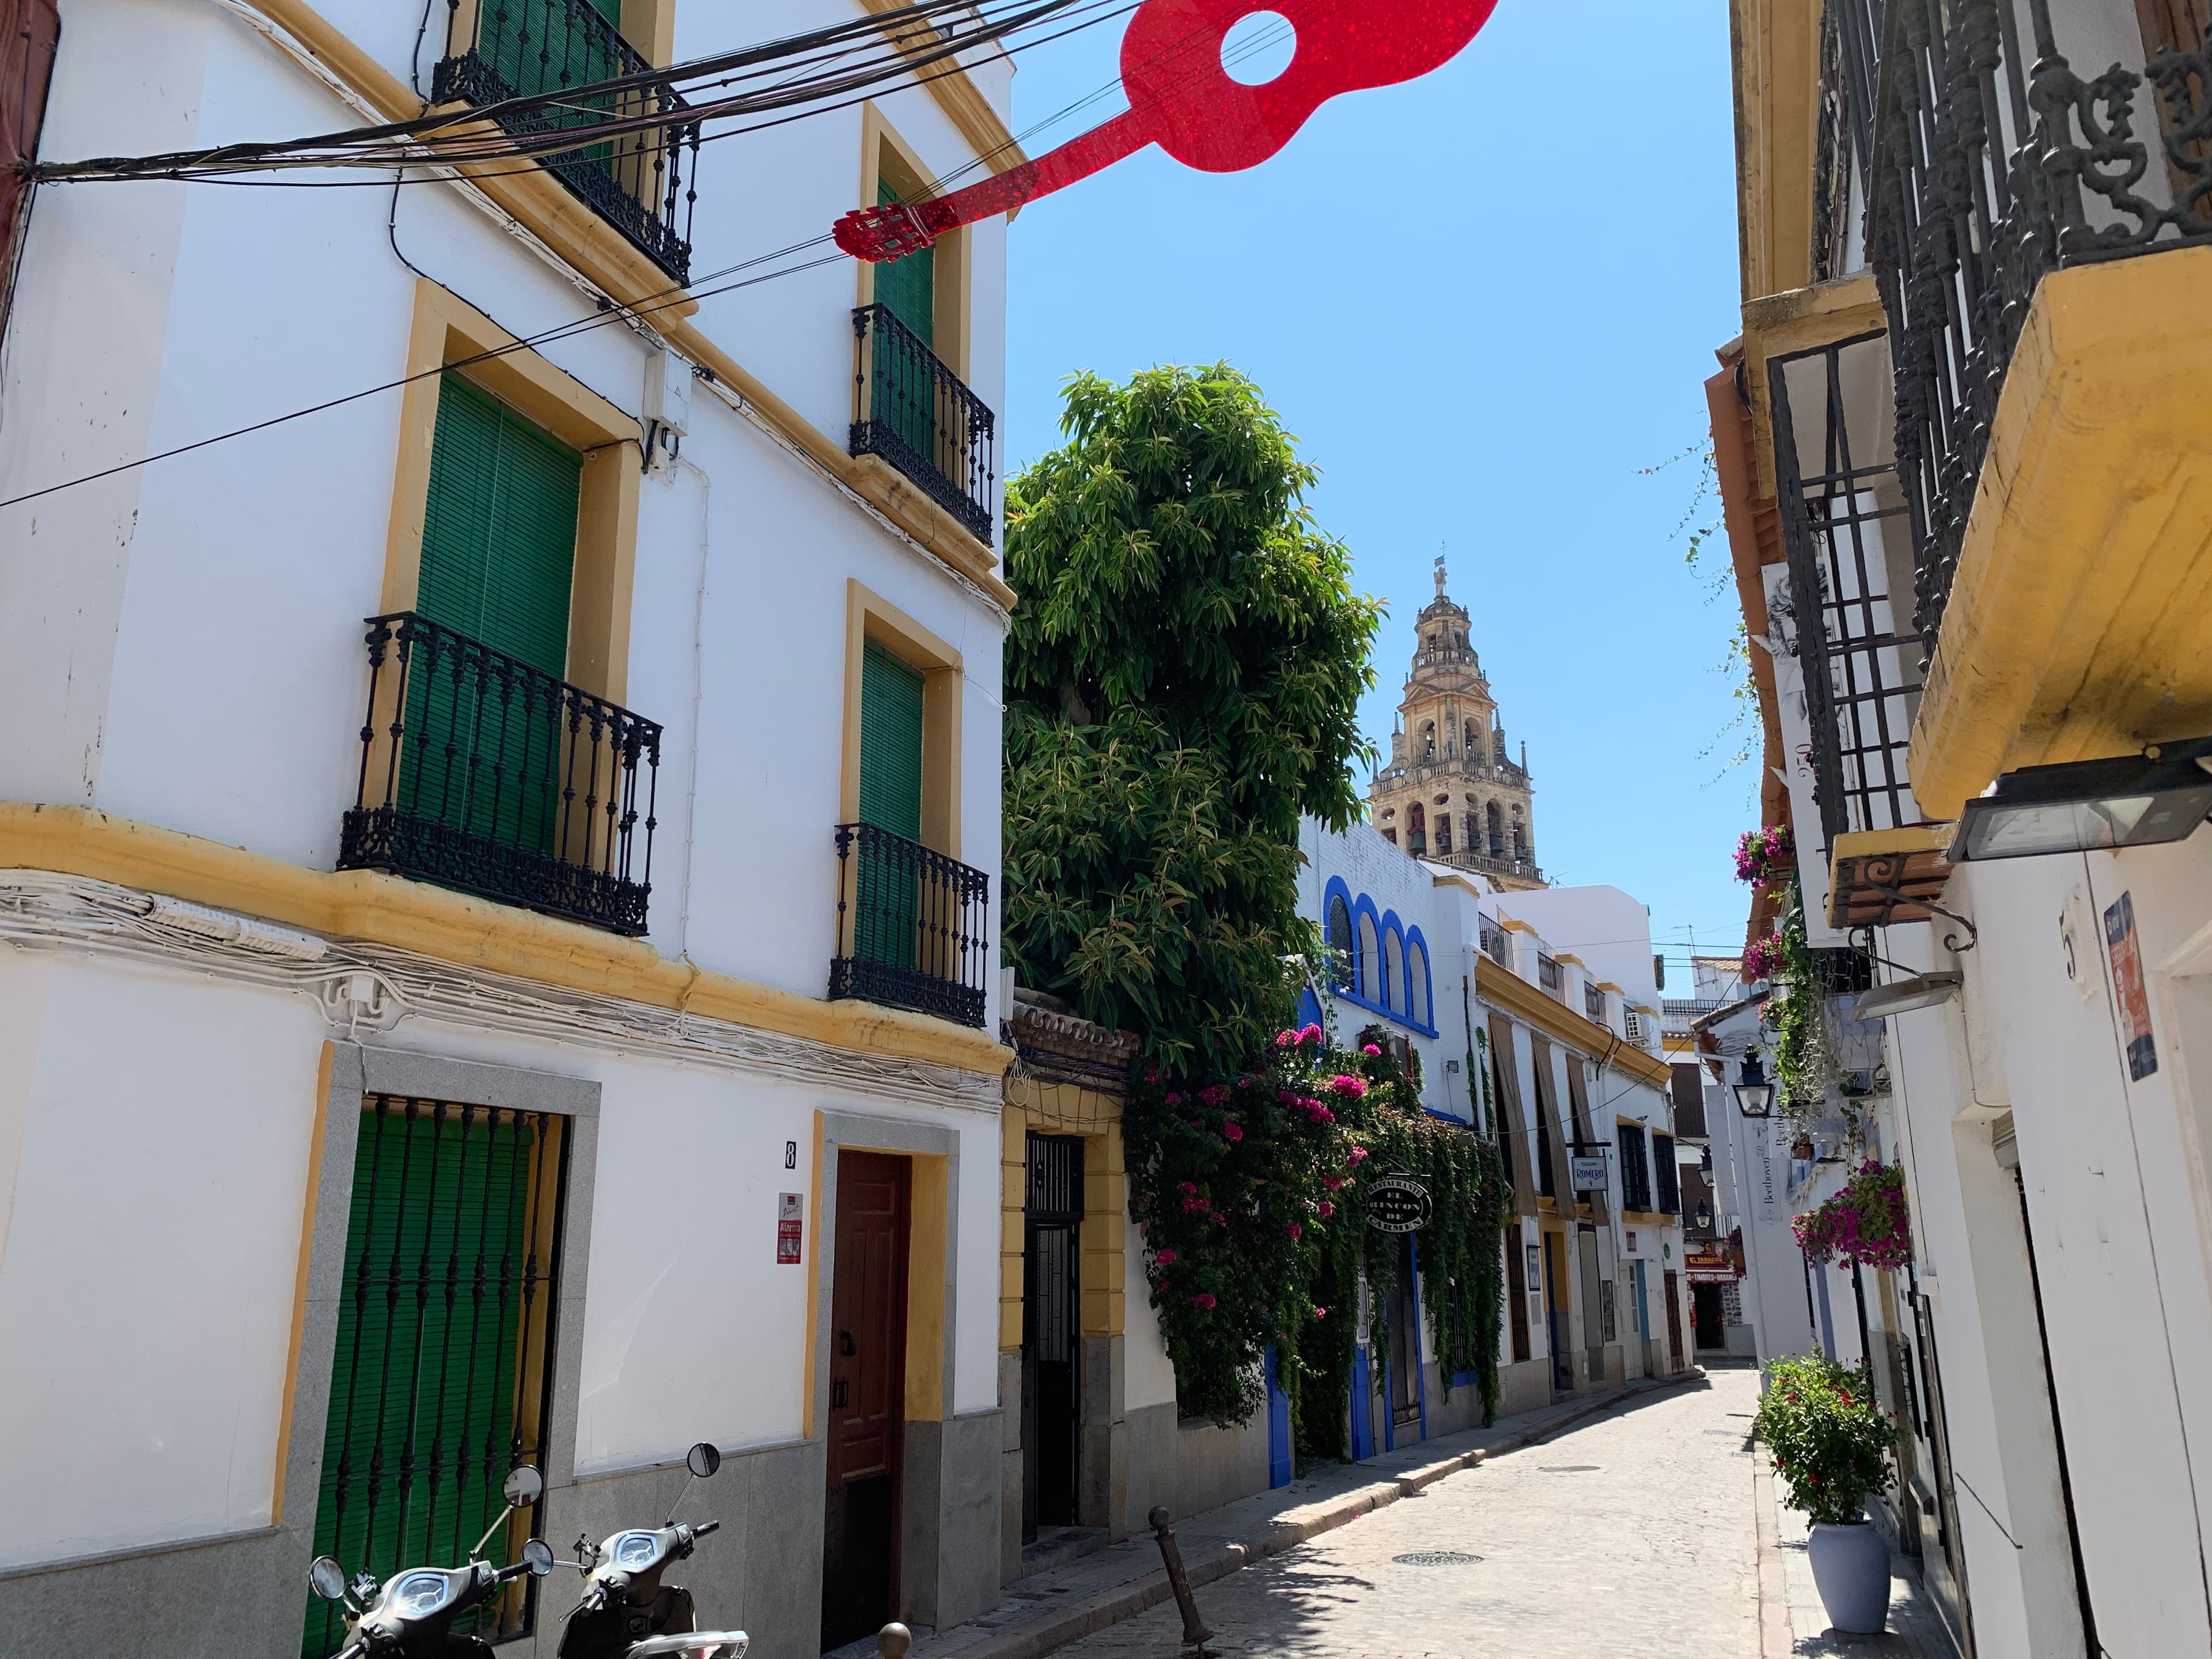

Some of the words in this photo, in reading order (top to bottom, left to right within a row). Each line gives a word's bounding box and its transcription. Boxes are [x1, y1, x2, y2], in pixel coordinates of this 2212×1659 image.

[786, 1143, 795, 1167] 8
[1576, 1168, 1604, 1180] ROMERO
[1762, 1157, 1774, 1205] Beethoven
[1368, 1179, 1423, 1198] RESTAURANTE
[1369, 1202, 1421, 1211] RINCON
[780, 1222, 801, 1232] Alarma
[1368, 1215, 1423, 1232] CARMEN
